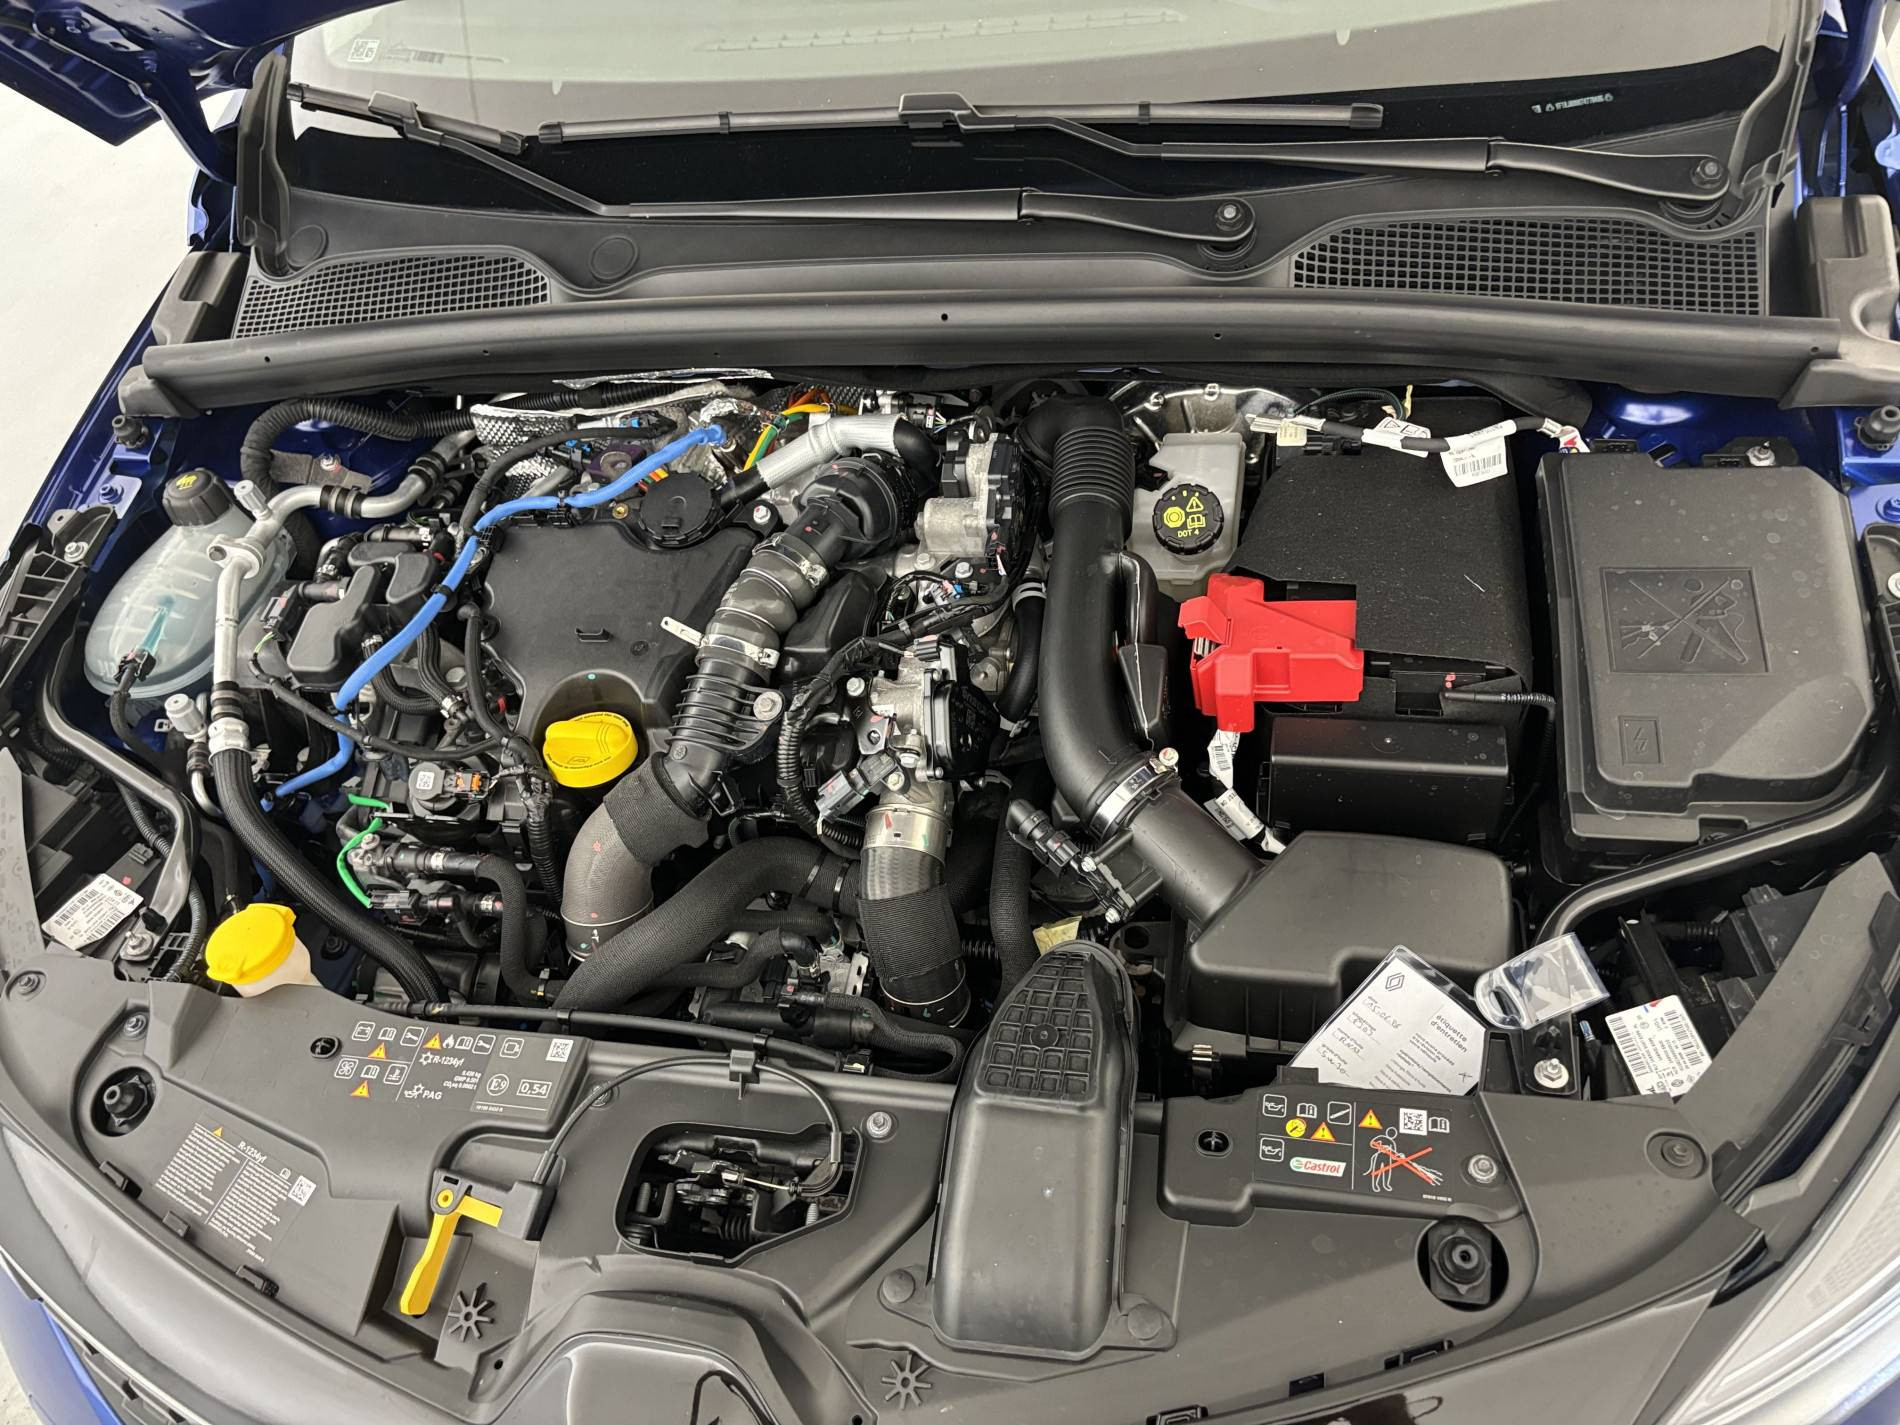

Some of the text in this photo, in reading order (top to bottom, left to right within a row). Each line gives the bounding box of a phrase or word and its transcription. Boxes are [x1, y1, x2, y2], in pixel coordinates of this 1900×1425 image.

[1177, 529, 1192, 537] DOT
[1436, 1014, 1467, 1042] étiquette
[1431, 1020, 1467, 1053] d'entretien
[432, 1055, 464, 1068] R-1234yf
[422, 1089, 443, 1100] PAG
[520, 1082, 548, 1095] 0,54
[238, 1141, 268, 1164] R-1234yf
[1303, 1160, 1342, 1174] Castrol
